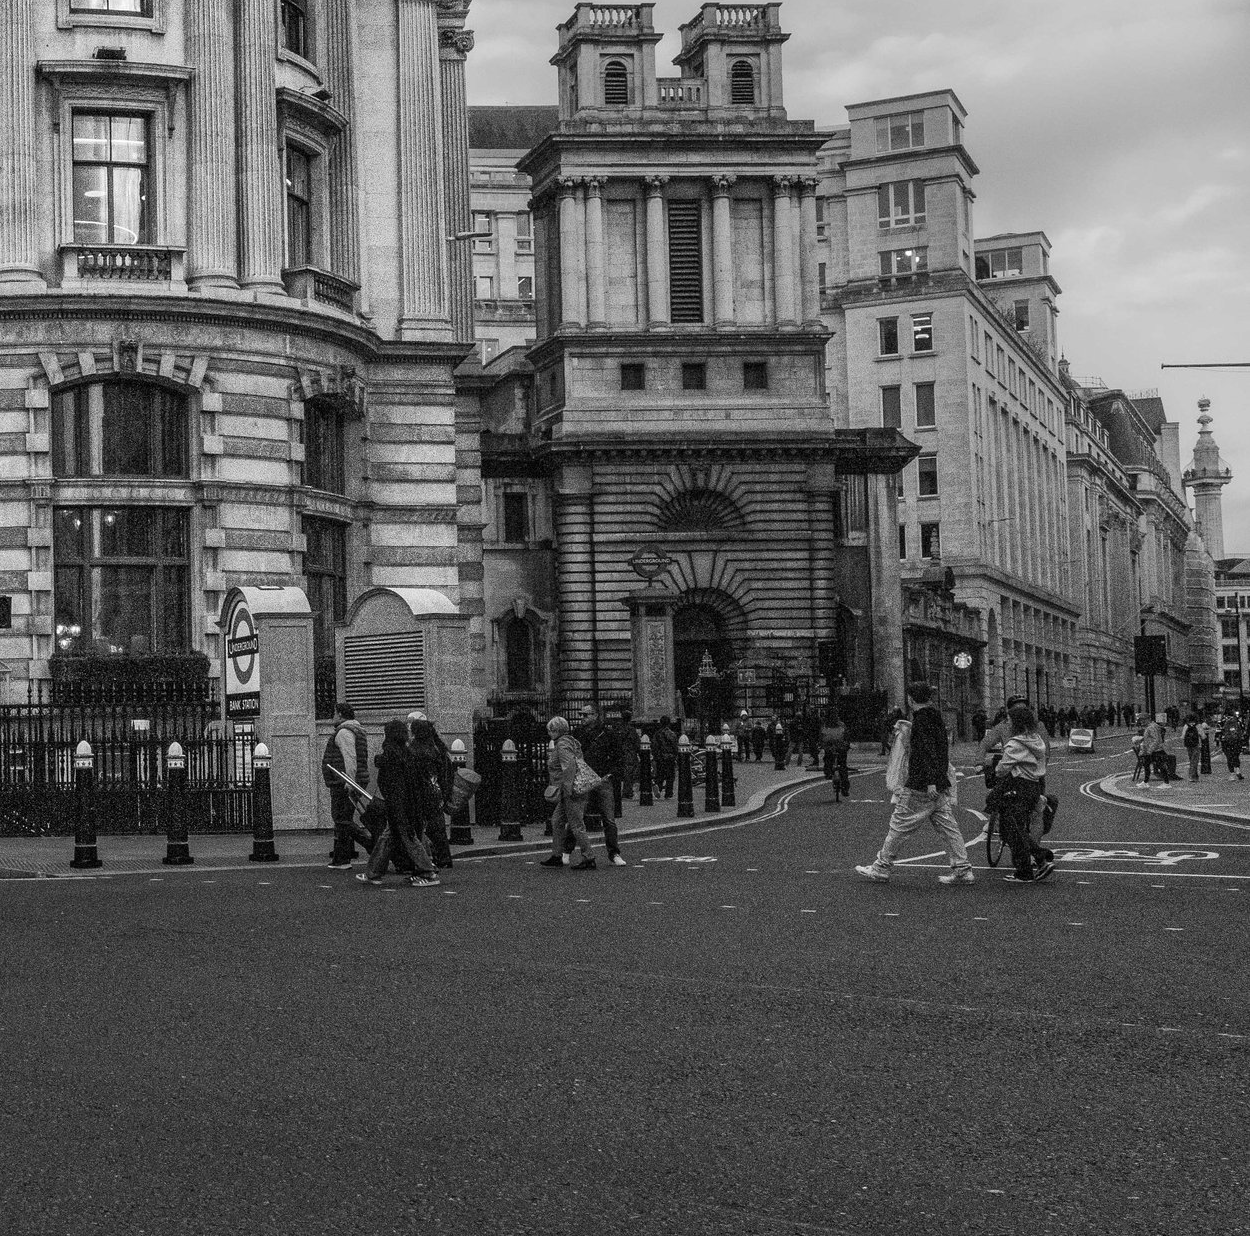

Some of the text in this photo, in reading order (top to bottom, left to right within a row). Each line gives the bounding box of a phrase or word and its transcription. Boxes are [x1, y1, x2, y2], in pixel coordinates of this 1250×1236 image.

[229, 637, 258, 655] UNDERGROUND
[229, 698, 259, 711] BANK STATION
